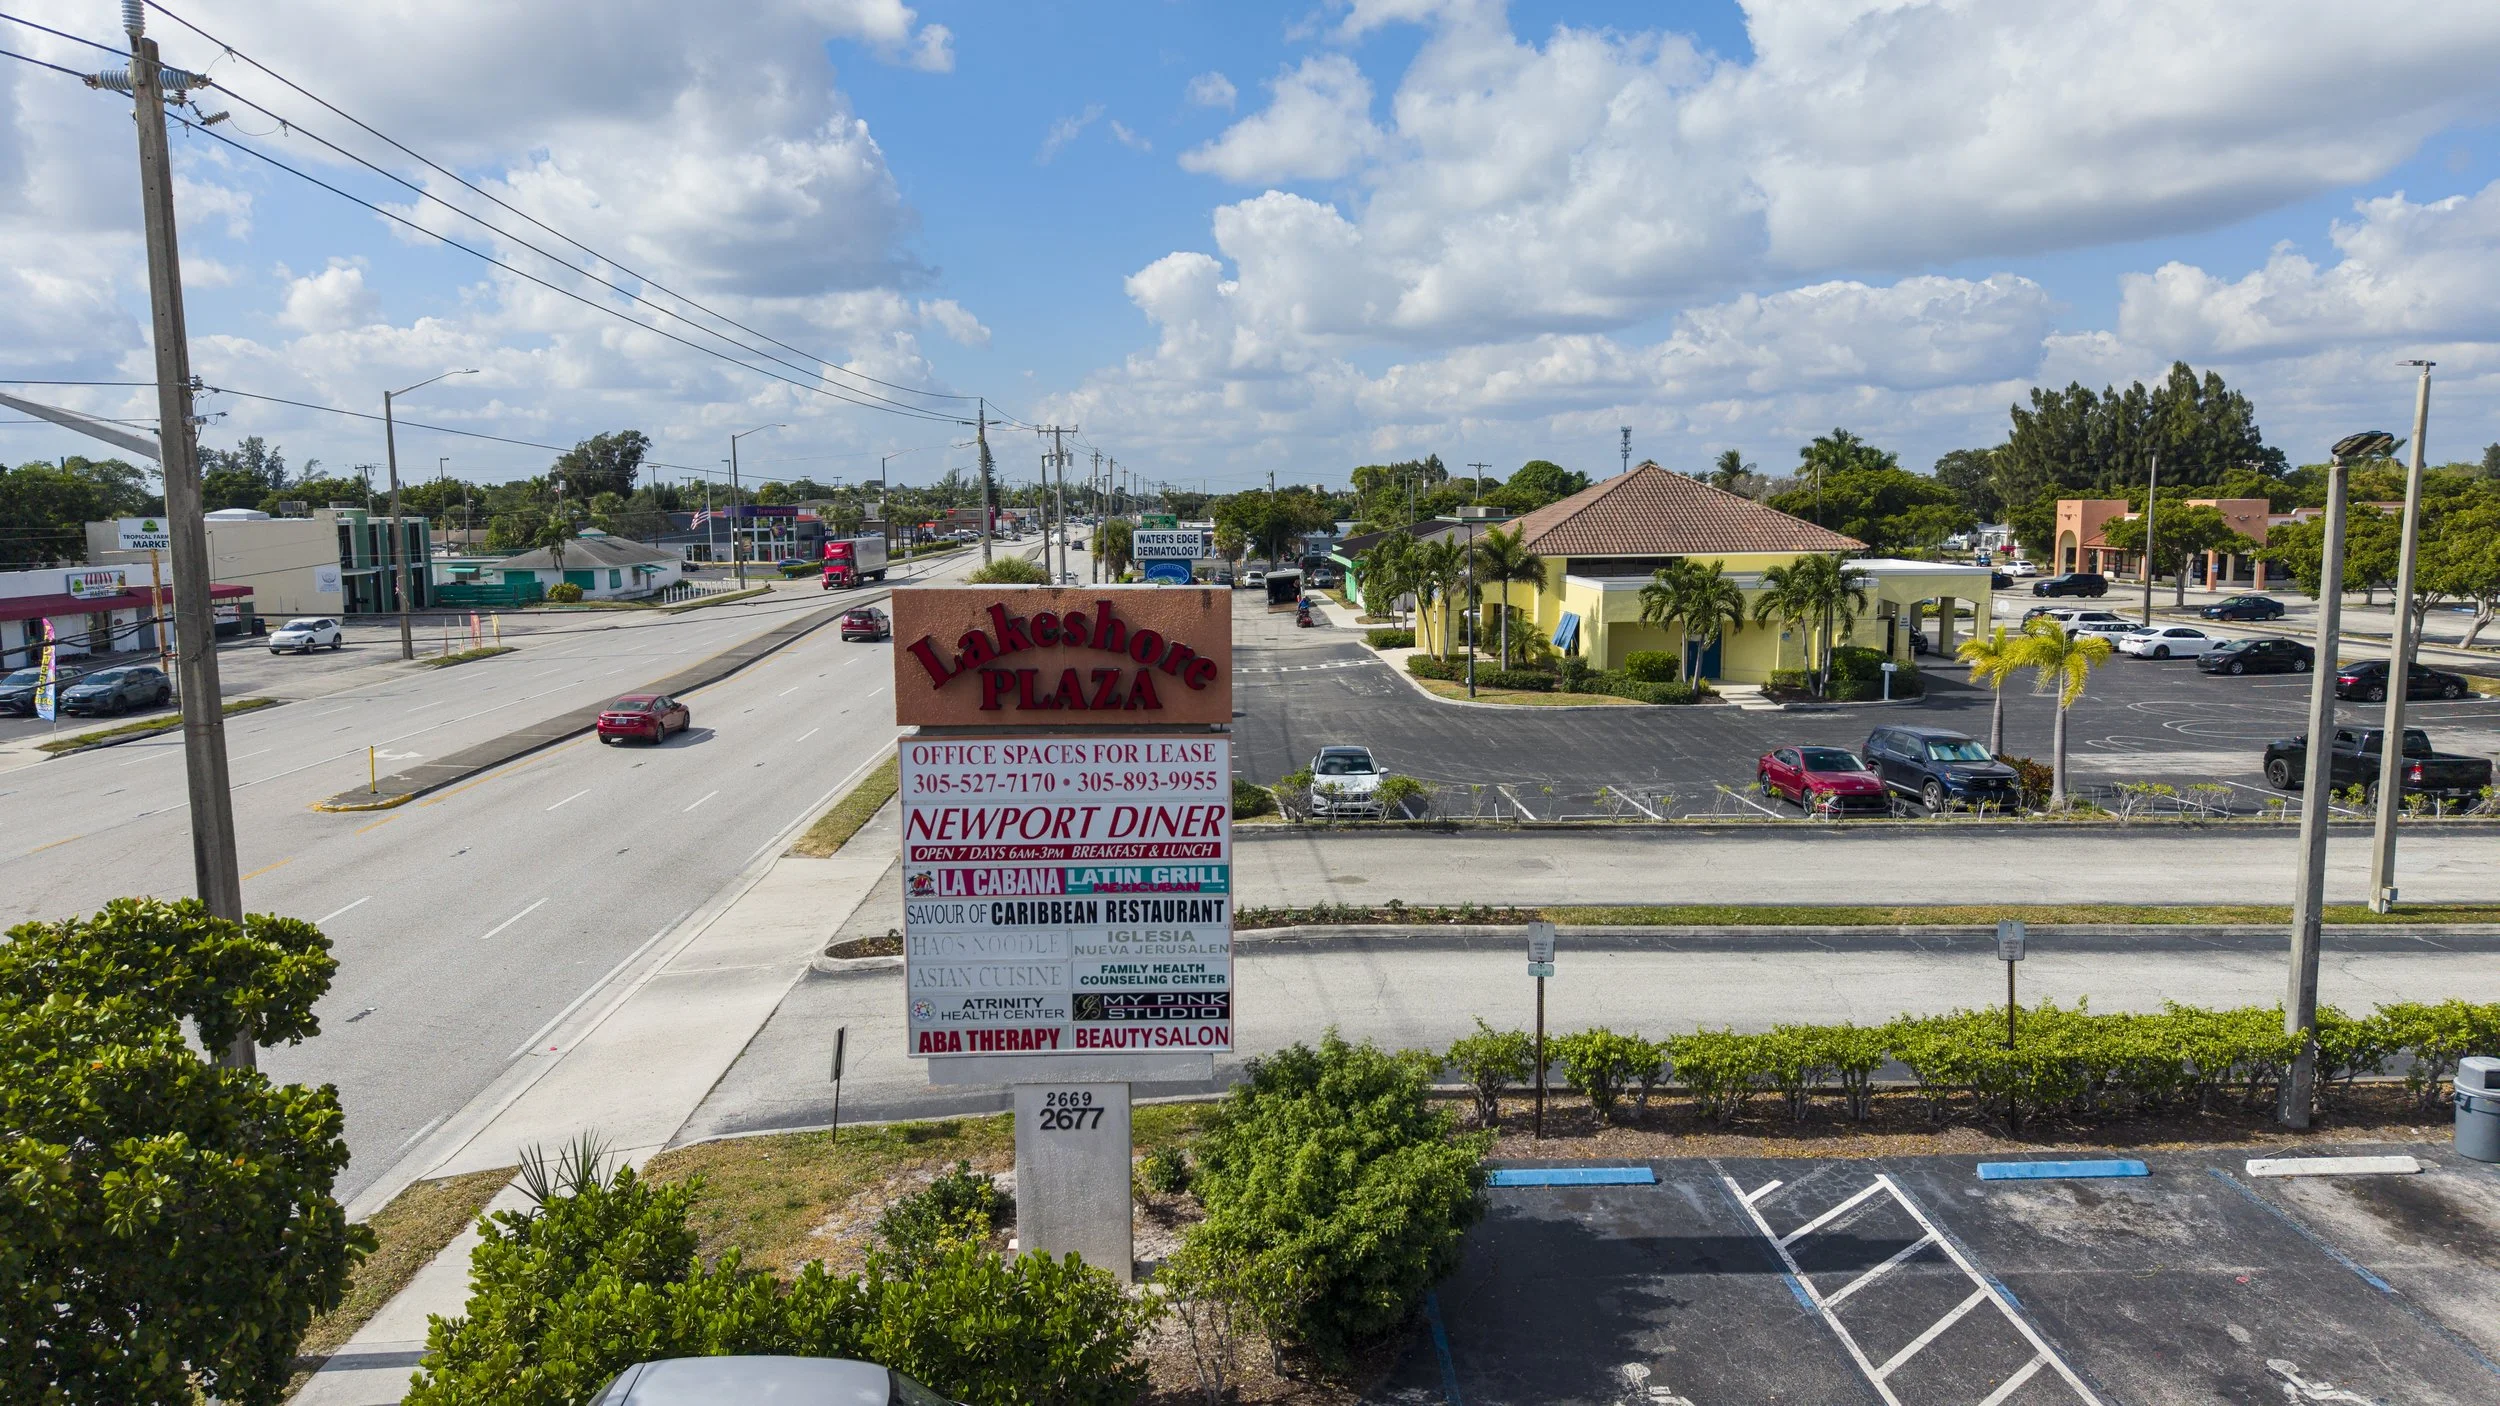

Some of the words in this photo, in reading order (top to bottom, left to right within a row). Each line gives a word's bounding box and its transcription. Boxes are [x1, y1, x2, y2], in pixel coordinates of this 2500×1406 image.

[1138, 534, 1174, 544] WATER'S
[1176, 534, 1199, 544] EDGE
[1137, 546, 1199, 556] DERMATOLOGY
[907, 600, 1218, 691] Lakeshore
[979, 668, 1163, 711] PLAZA
[912, 745, 997, 765] OFFICE
[1003, 744, 1087, 765] SPACES
[1093, 744, 1140, 764] FOR
[1145, 743, 1217, 763] LEASE
[913, 773, 1056, 793] 305-527-7170
[1077, 771, 1217, 792] 305-893-9955
[905, 806, 1101, 840] NEWPORT
[1108, 805, 1226, 838] DINER
[915, 847, 955, 861] OPEN
[957, 847, 967, 860] 7
[969, 846, 1006, 860] DAYS
[1071, 844, 1147, 858] BREAKFAST
[1148, 844, 1159, 857] &
[1162, 844, 1214, 857] LUNCH
[940, 869, 967, 896] LA
[973, 868, 1060, 896] CABANA
[1068, 867, 1141, 885] LATIN
[1151, 867, 1224, 883] GRILL
[1093, 882, 1200, 893] MEXICUBAN
[907, 904, 964, 924] SAVOUR
[969, 904, 988, 923] OF
[991, 901, 1098, 925] CARIBBEAN
[1106, 900, 1224, 923] RESTAURANT
[973, 934, 1060, 955] NOODLE
[1107, 930, 1195, 943] IGLESIA
[1074, 945, 1129, 955] NUEVA
[1134, 943, 1230, 955] JERUSALEN
[914, 966, 972, 988] ASIAN
[979, 965, 1062, 986] CUISINE
[1101, 964, 1149, 974] FAMILY
[1153, 963, 1205, 974] HEALTH
[1080, 975, 1168, 985] COUNSELING
[1172, 974, 1226, 985] CENTER
[962, 997, 1044, 1010] ATRINITY
[1103, 995, 1145, 1006] MY
[1157, 994, 1228, 1005] PINK
[941, 1010, 999, 1021] HEALTH
[1003, 1008, 1065, 1020] CENTER
[1108, 1007, 1220, 1019] STUDIO
[918, 1030, 962, 1053] ABA
[966, 1027, 1061, 1052] THERAPY
[1076, 1027, 1153, 1048] BEAUTY
[1154, 1026, 1229, 1046] SALON
[1046, 1091, 1092, 1107] 2669
[1039, 1107, 1104, 1130] 2677
